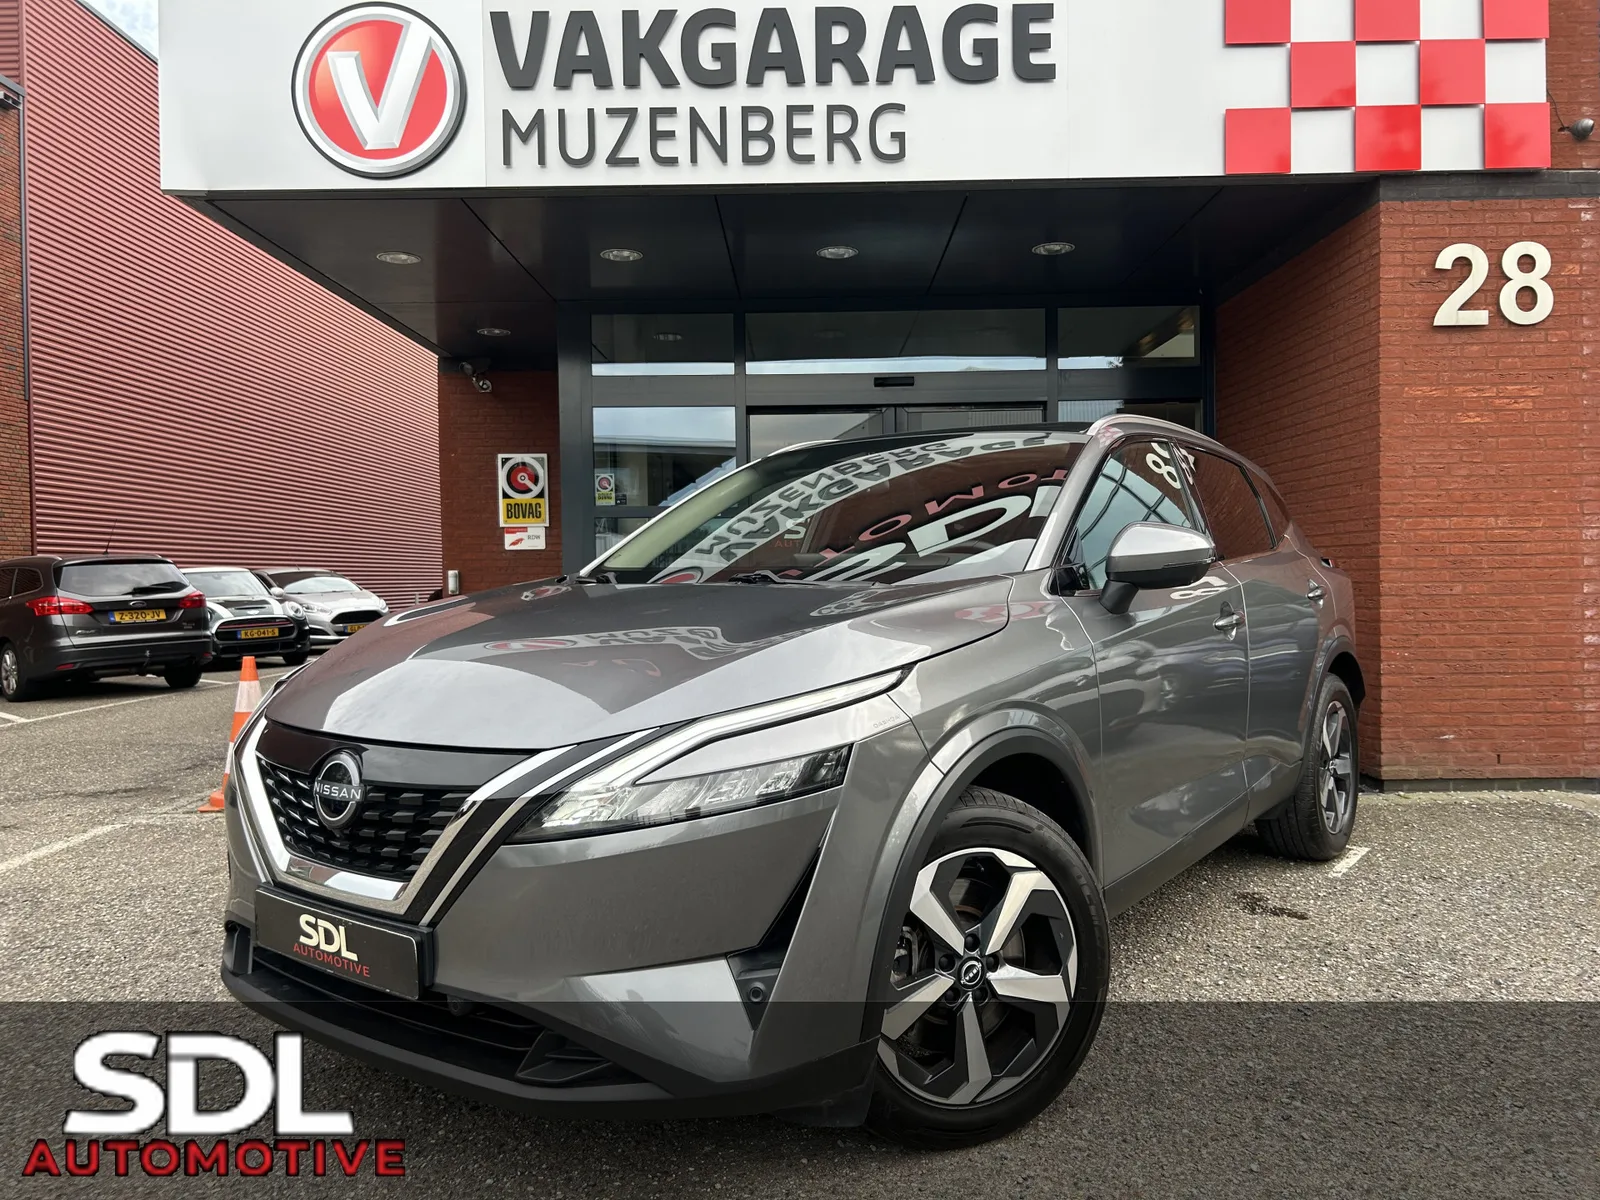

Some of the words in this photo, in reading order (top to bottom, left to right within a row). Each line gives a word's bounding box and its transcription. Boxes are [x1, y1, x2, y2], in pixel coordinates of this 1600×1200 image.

[489, 3, 1057, 90] VAKGARAGE
[502, 102, 907, 168] MUZENBERG
[1433, 241, 1554, 326] 28
[506, 502, 542, 519] BOVAG
[119, 610, 161, 620] Z-320-JV
[244, 629, 276, 637] KG-041-S
[314, 781, 362, 800] NISSAN
[299, 913, 359, 961] SDL
[293, 942, 371, 977] AUTOMOTIVE
